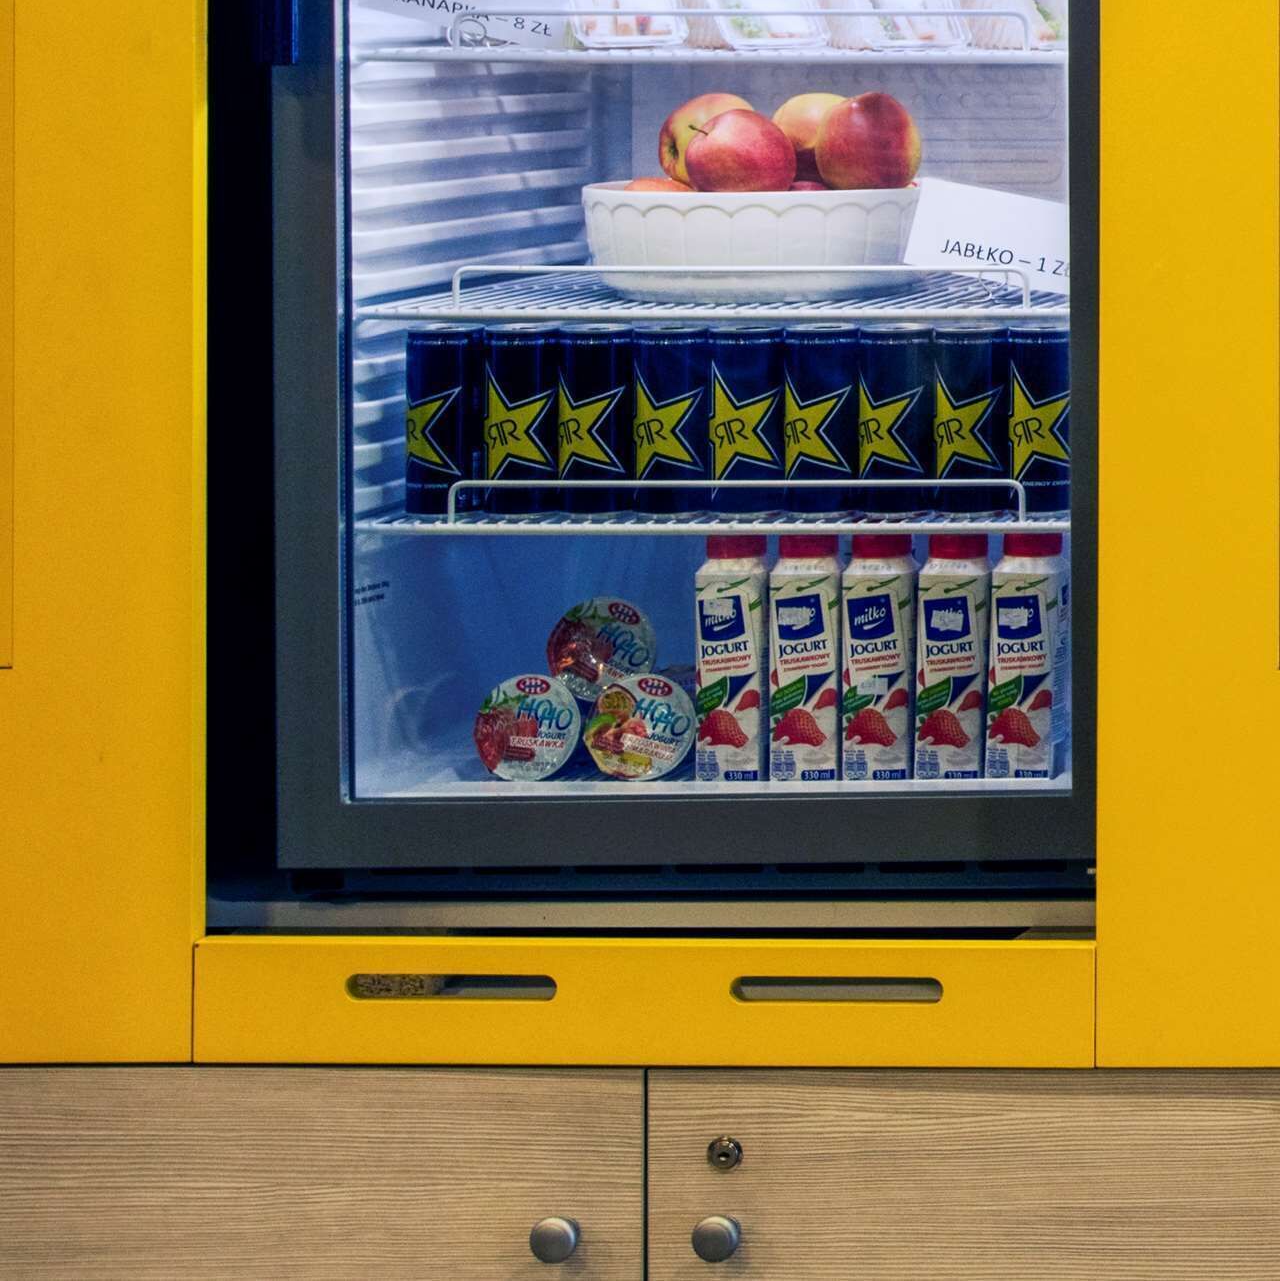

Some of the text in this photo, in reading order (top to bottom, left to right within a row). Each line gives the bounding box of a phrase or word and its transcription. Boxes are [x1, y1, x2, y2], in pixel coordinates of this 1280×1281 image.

[513, 16, 525, 31] 8
[530, 20, 553, 38] ZŁ
[940, 239, 1014, 265] JABŁKO
[1036, 257, 1046, 272] 1
[854, 605, 887, 627] milko
[701, 640, 749, 657] JOGURT
[779, 639, 828, 658] JOGURT
[850, 638, 898, 658] JOGURT
[925, 640, 974, 658] JOGURT
[997, 639, 1045, 657] JOGURT
[727, 771, 742, 780] 330
[804, 771, 820, 780] 330
